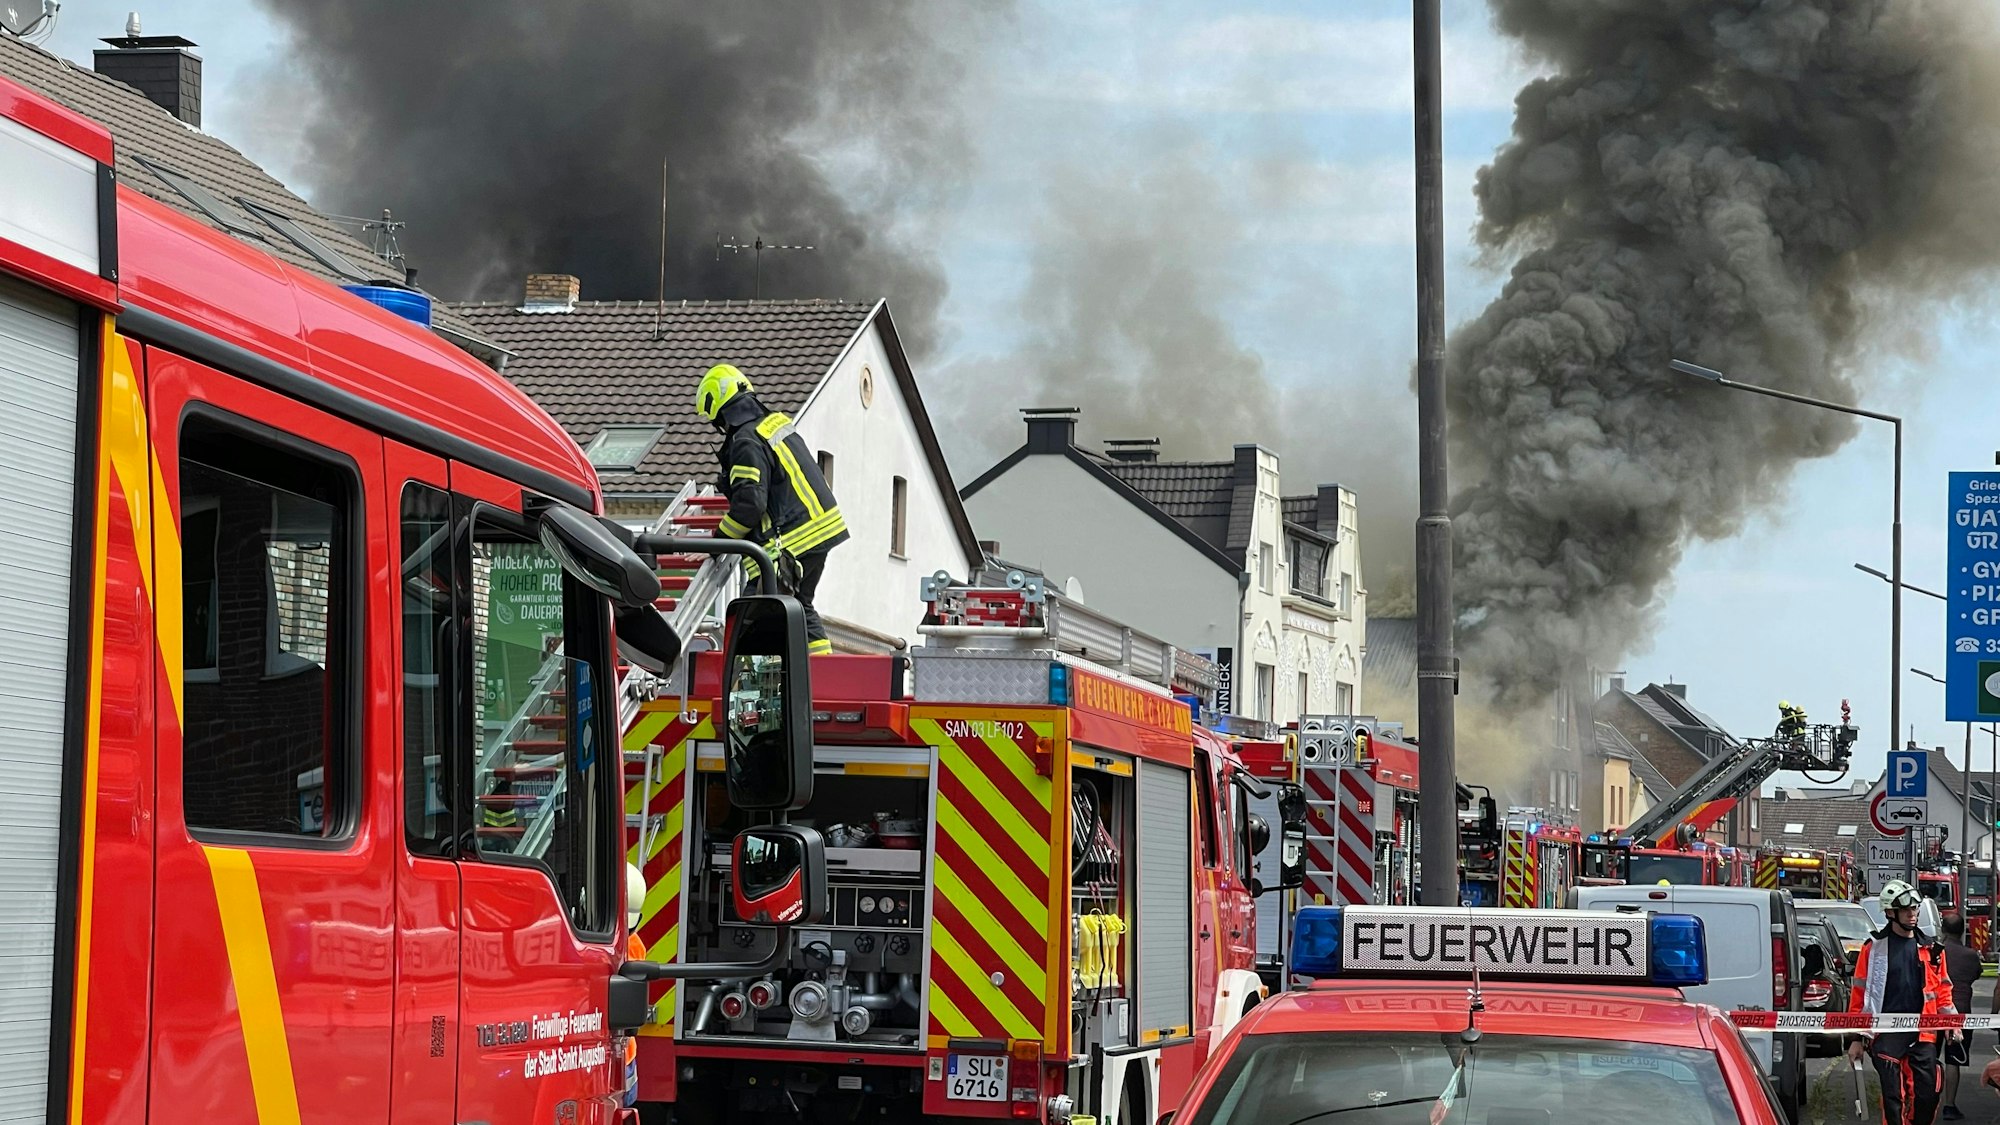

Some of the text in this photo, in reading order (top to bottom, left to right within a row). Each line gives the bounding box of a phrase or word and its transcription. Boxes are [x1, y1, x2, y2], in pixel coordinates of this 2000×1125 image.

[1969, 480, 2000, 490] Grie
[1956, 509, 2000, 528] GIA
[501, 574, 538, 591] HOHER
[510, 594, 545, 603] GARANTIERT
[1219, 662, 1230, 715] NNECK
[1079, 674, 1172, 730] FEUERWEHR 112
[945, 720, 969, 738] SAN
[971, 721, 985, 738] 03
[1016, 722, 1024, 739] 2
[1896, 757, 1918, 792] P
[1879, 850, 1895, 860] 200
[1353, 923, 1634, 966] FEUERWEHR
[532, 1007, 602, 1042] Freiwillige Feuerwehr
[524, 1041, 606, 1078] der Stadt Sankt Augustin
[968, 1058, 991, 1077] SU
[954, 1079, 999, 1098] 6716
